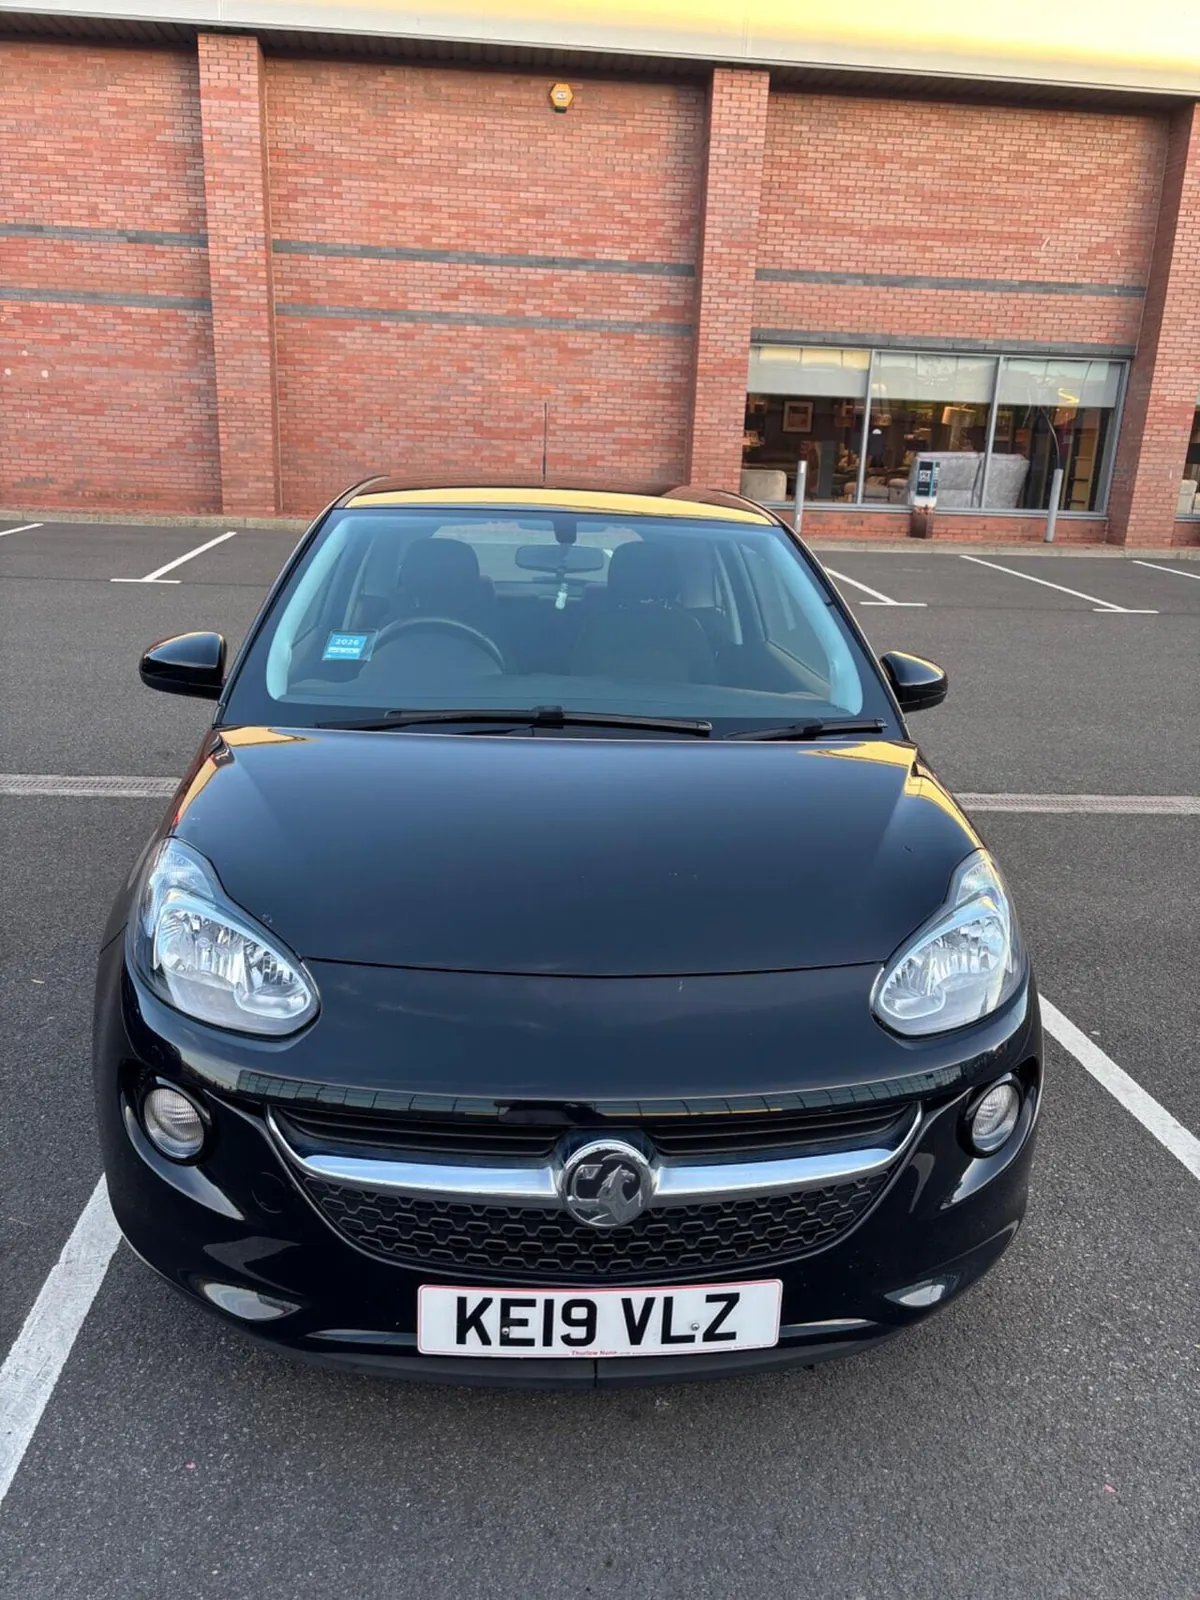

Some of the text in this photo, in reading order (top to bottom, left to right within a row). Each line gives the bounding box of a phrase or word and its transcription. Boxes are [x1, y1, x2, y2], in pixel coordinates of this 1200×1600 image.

[335, 638, 360, 646] 2026
[456, 1292, 741, 1347] KE19 VLZ
